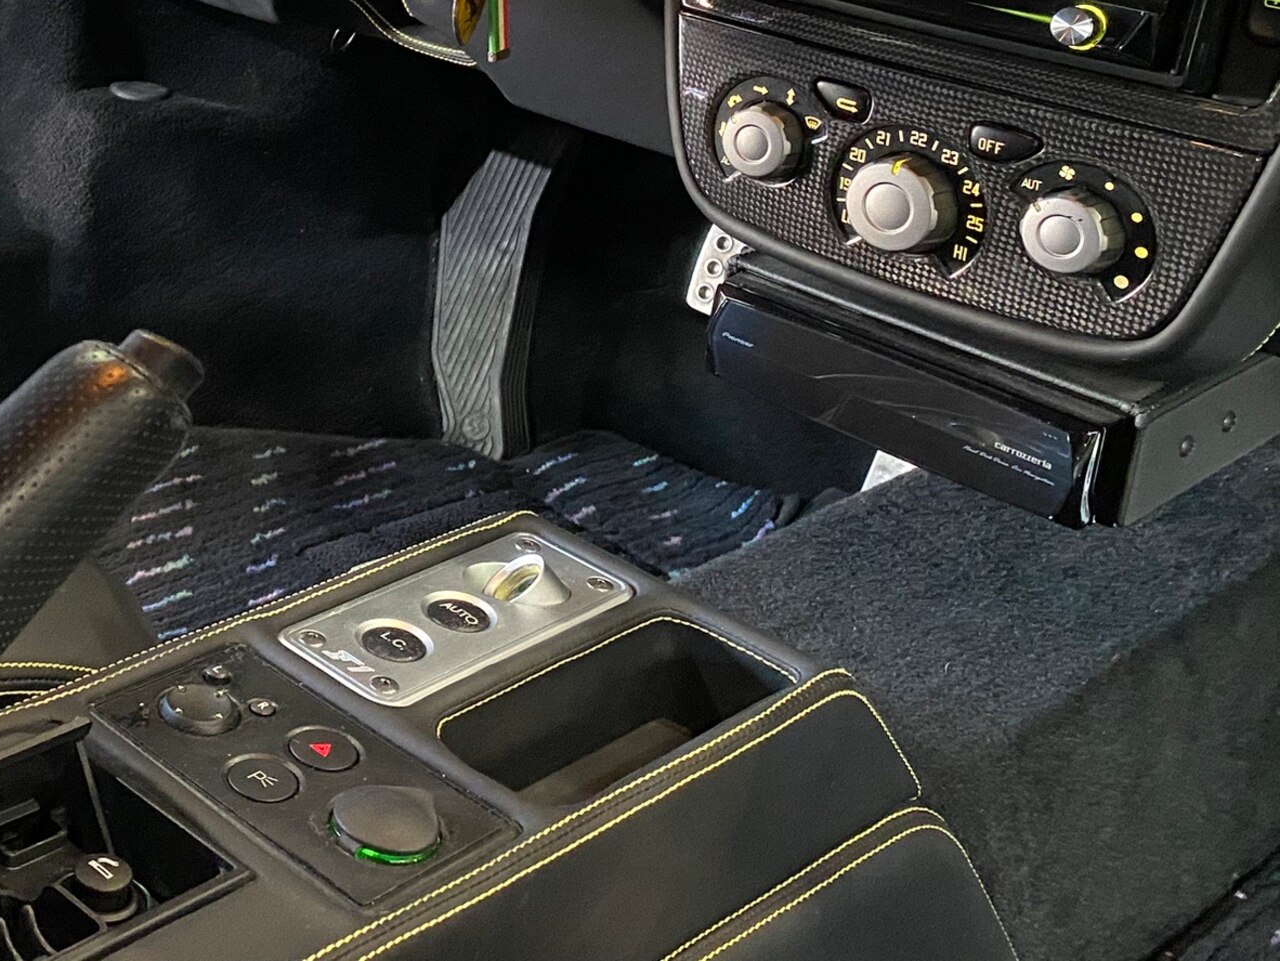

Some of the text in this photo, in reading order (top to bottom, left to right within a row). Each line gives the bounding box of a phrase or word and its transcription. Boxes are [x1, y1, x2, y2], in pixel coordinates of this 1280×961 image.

[876, 131, 891, 146] 21
[910, 130, 928, 147] 22
[978, 137, 1006, 155] OFF
[849, 146, 867, 163] 20
[941, 149, 959, 166] 23
[963, 180, 981, 197] 24
[1021, 178, 1043, 191] AUT
[841, 209, 851, 225] L
[966, 215, 984, 232] 25
[953, 245, 968, 262] HI
[993, 441, 1053, 471] carrozzeria
[438, 601, 479, 626] AUTO
[257, 701, 270, 710] R
